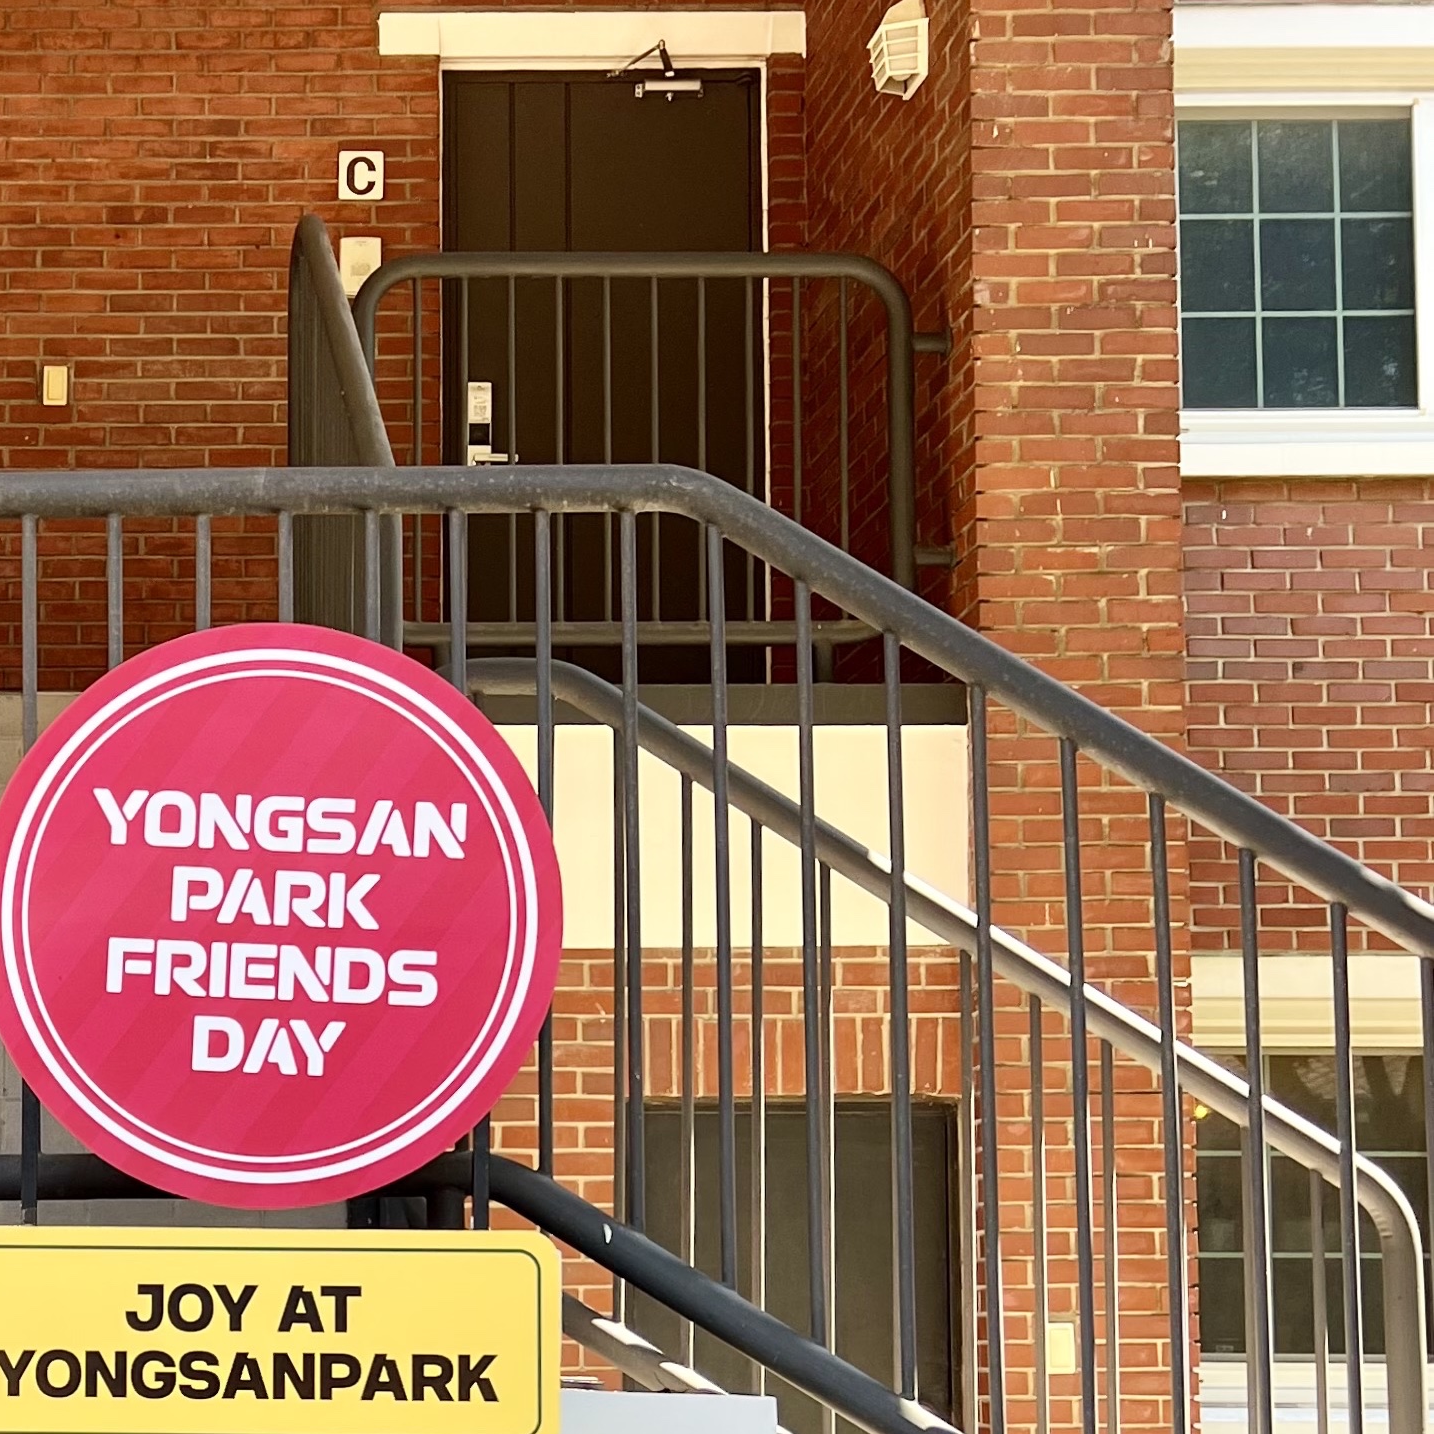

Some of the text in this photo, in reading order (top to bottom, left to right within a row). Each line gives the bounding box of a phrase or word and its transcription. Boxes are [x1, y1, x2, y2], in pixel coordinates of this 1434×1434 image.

[346, 156, 377, 196] C
[93, 787, 468, 860] YONGSAN
[170, 865, 381, 931] PARK
[105, 936, 439, 1008] FRIENDS
[190, 1015, 347, 1077] DAY
[125, 1283, 363, 1334] JOY AT
